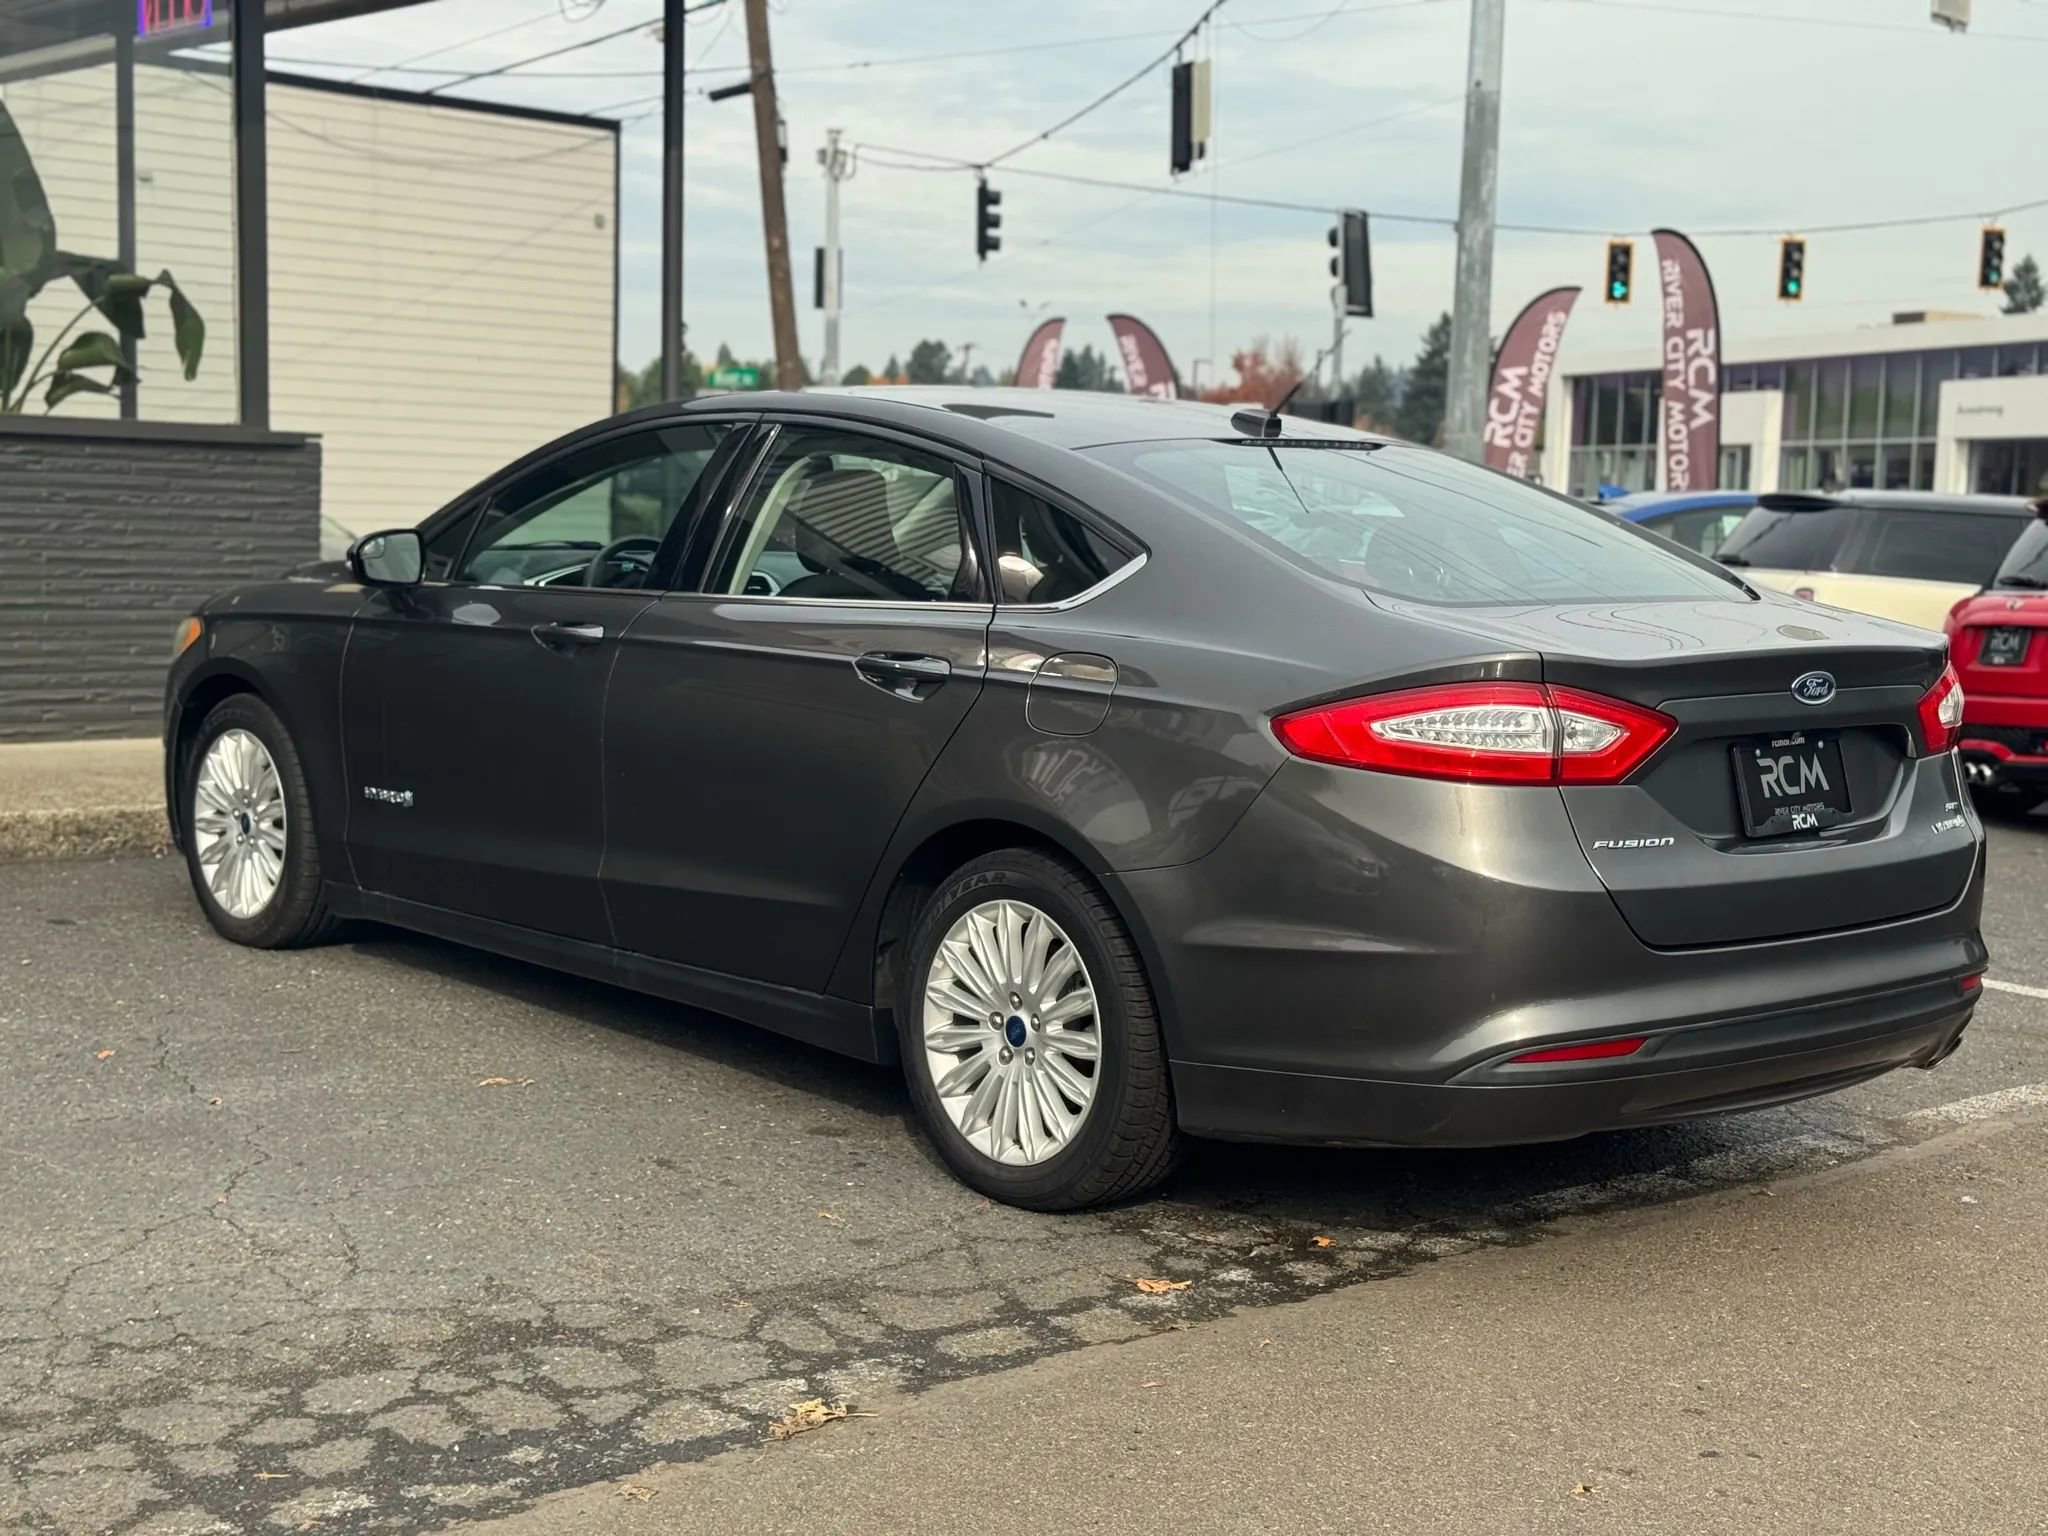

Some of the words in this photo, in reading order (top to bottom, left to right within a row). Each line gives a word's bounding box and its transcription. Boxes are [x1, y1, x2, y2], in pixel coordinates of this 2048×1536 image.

[1662, 258, 1683, 329] RIVER
[1513, 400, 1540, 449] CITY
[1528, 310, 1567, 397] MOTORS
[1665, 336, 1686, 391] CITY
[1686, 328, 1716, 430] RCM
[1483, 365, 1529, 448] RCM
[1668, 401, 1690, 492] MOTOR
[1803, 678, 1829, 697] Ford
[1756, 753, 1830, 798] RCM
[1774, 807, 1789, 816] RIVER
[1790, 805, 1802, 814] CITY
[1802, 802, 1825, 811] MOTORS
[1792, 813, 1819, 830] RCM
[1592, 837, 1675, 850] FUSION
